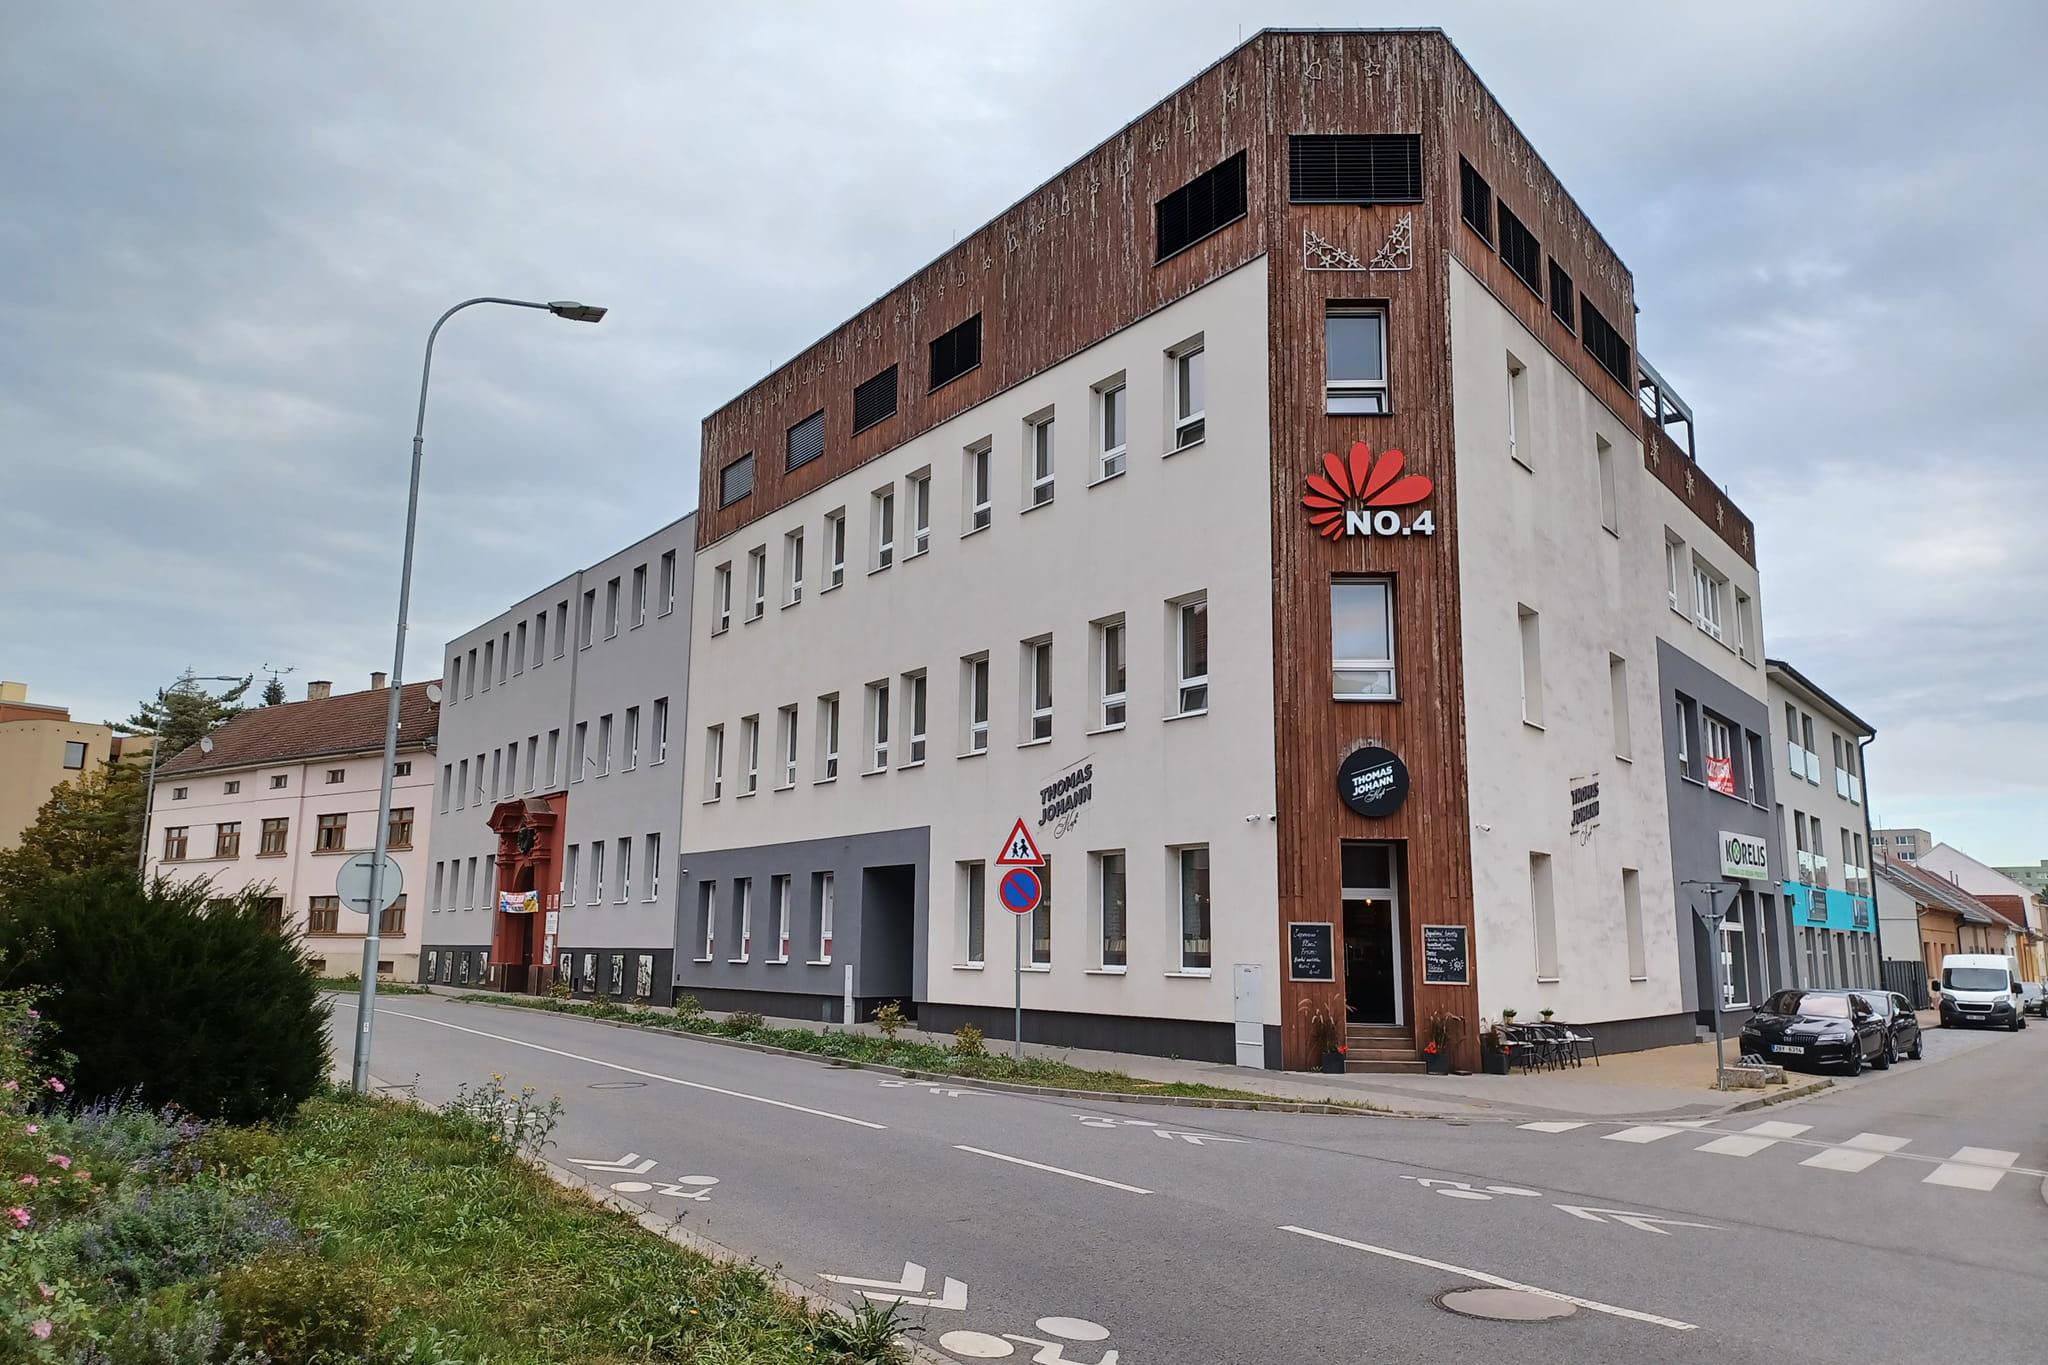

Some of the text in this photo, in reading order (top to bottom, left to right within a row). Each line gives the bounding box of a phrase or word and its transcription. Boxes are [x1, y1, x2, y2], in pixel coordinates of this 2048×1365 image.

[1346, 510, 1435, 536] NO.4
[1040, 763, 1093, 805] THOMAS
[1351, 765, 1393, 786] THOMAS
[1352, 775, 1394, 796] JOHANN
[1038, 783, 1092, 827] JOHANN
[1570, 782, 1599, 806] THOMAS
[1571, 800, 1600, 828] JOHANN
[1725, 838, 1766, 867] KORELIS
